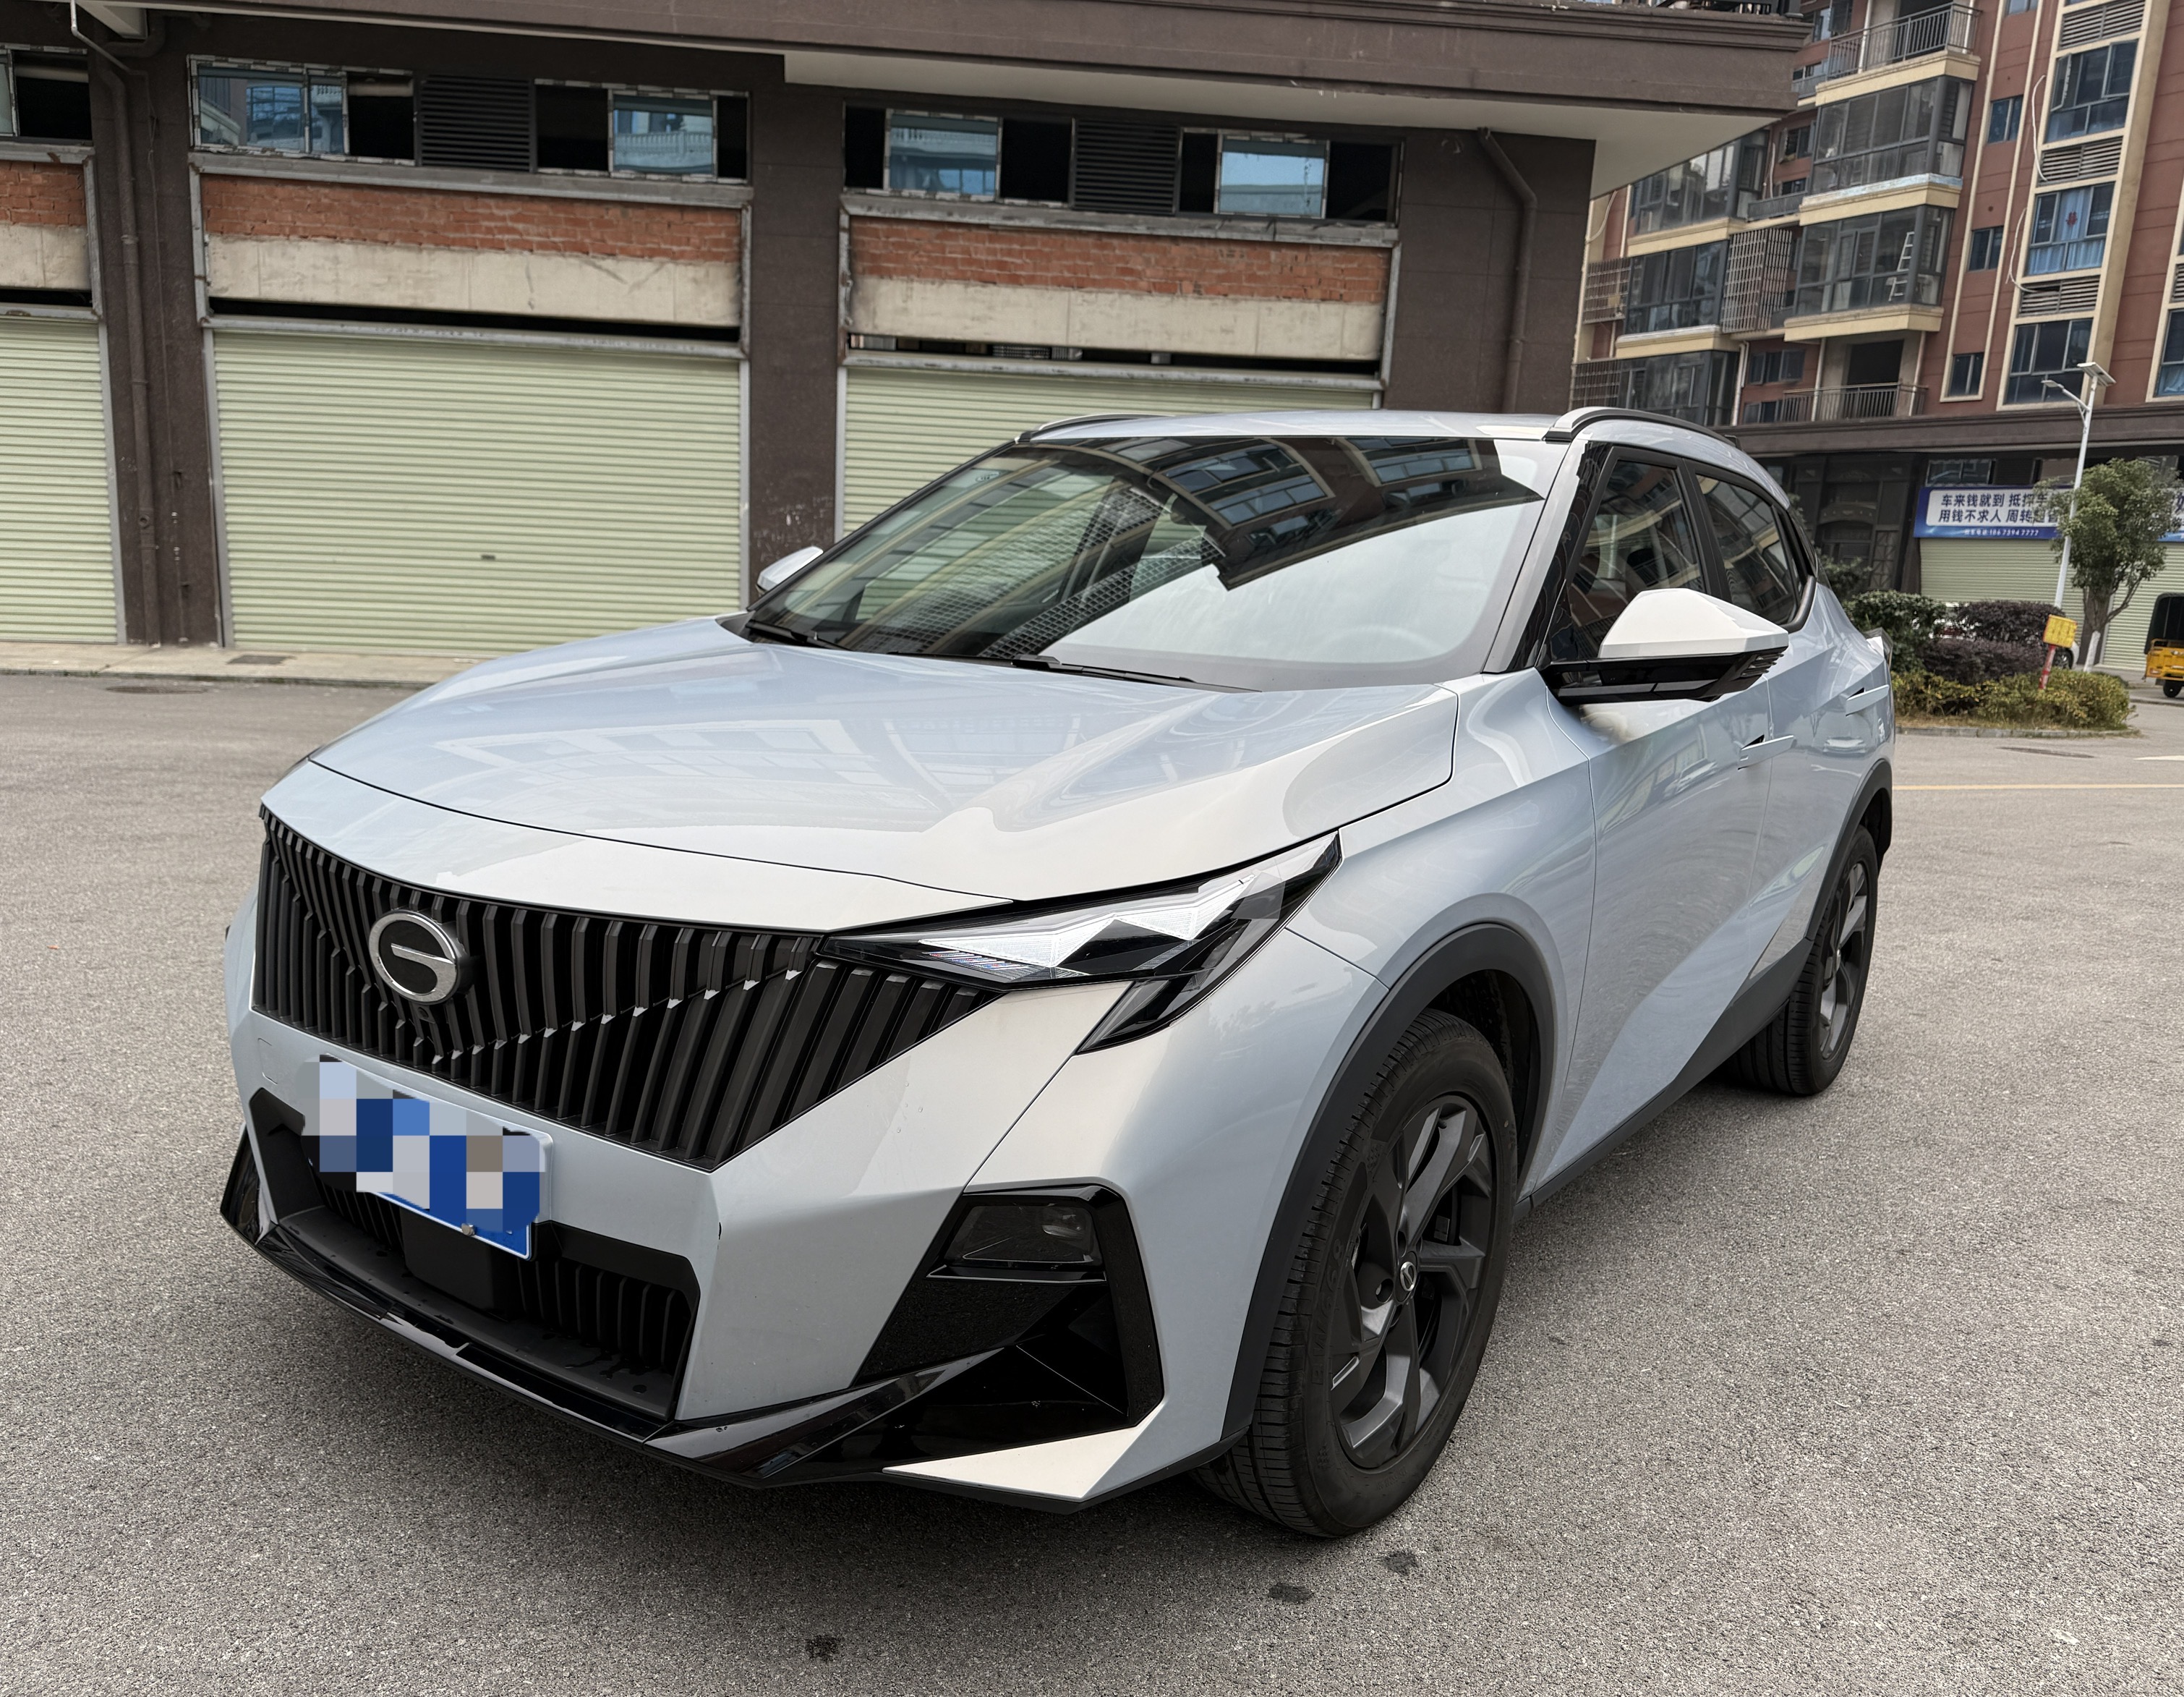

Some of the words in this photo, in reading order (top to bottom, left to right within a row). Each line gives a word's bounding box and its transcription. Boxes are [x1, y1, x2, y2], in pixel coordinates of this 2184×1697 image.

[1941, 493, 2005, 507] 车来钱就到
[1938, 509, 2002, 523] 用钱不求人
